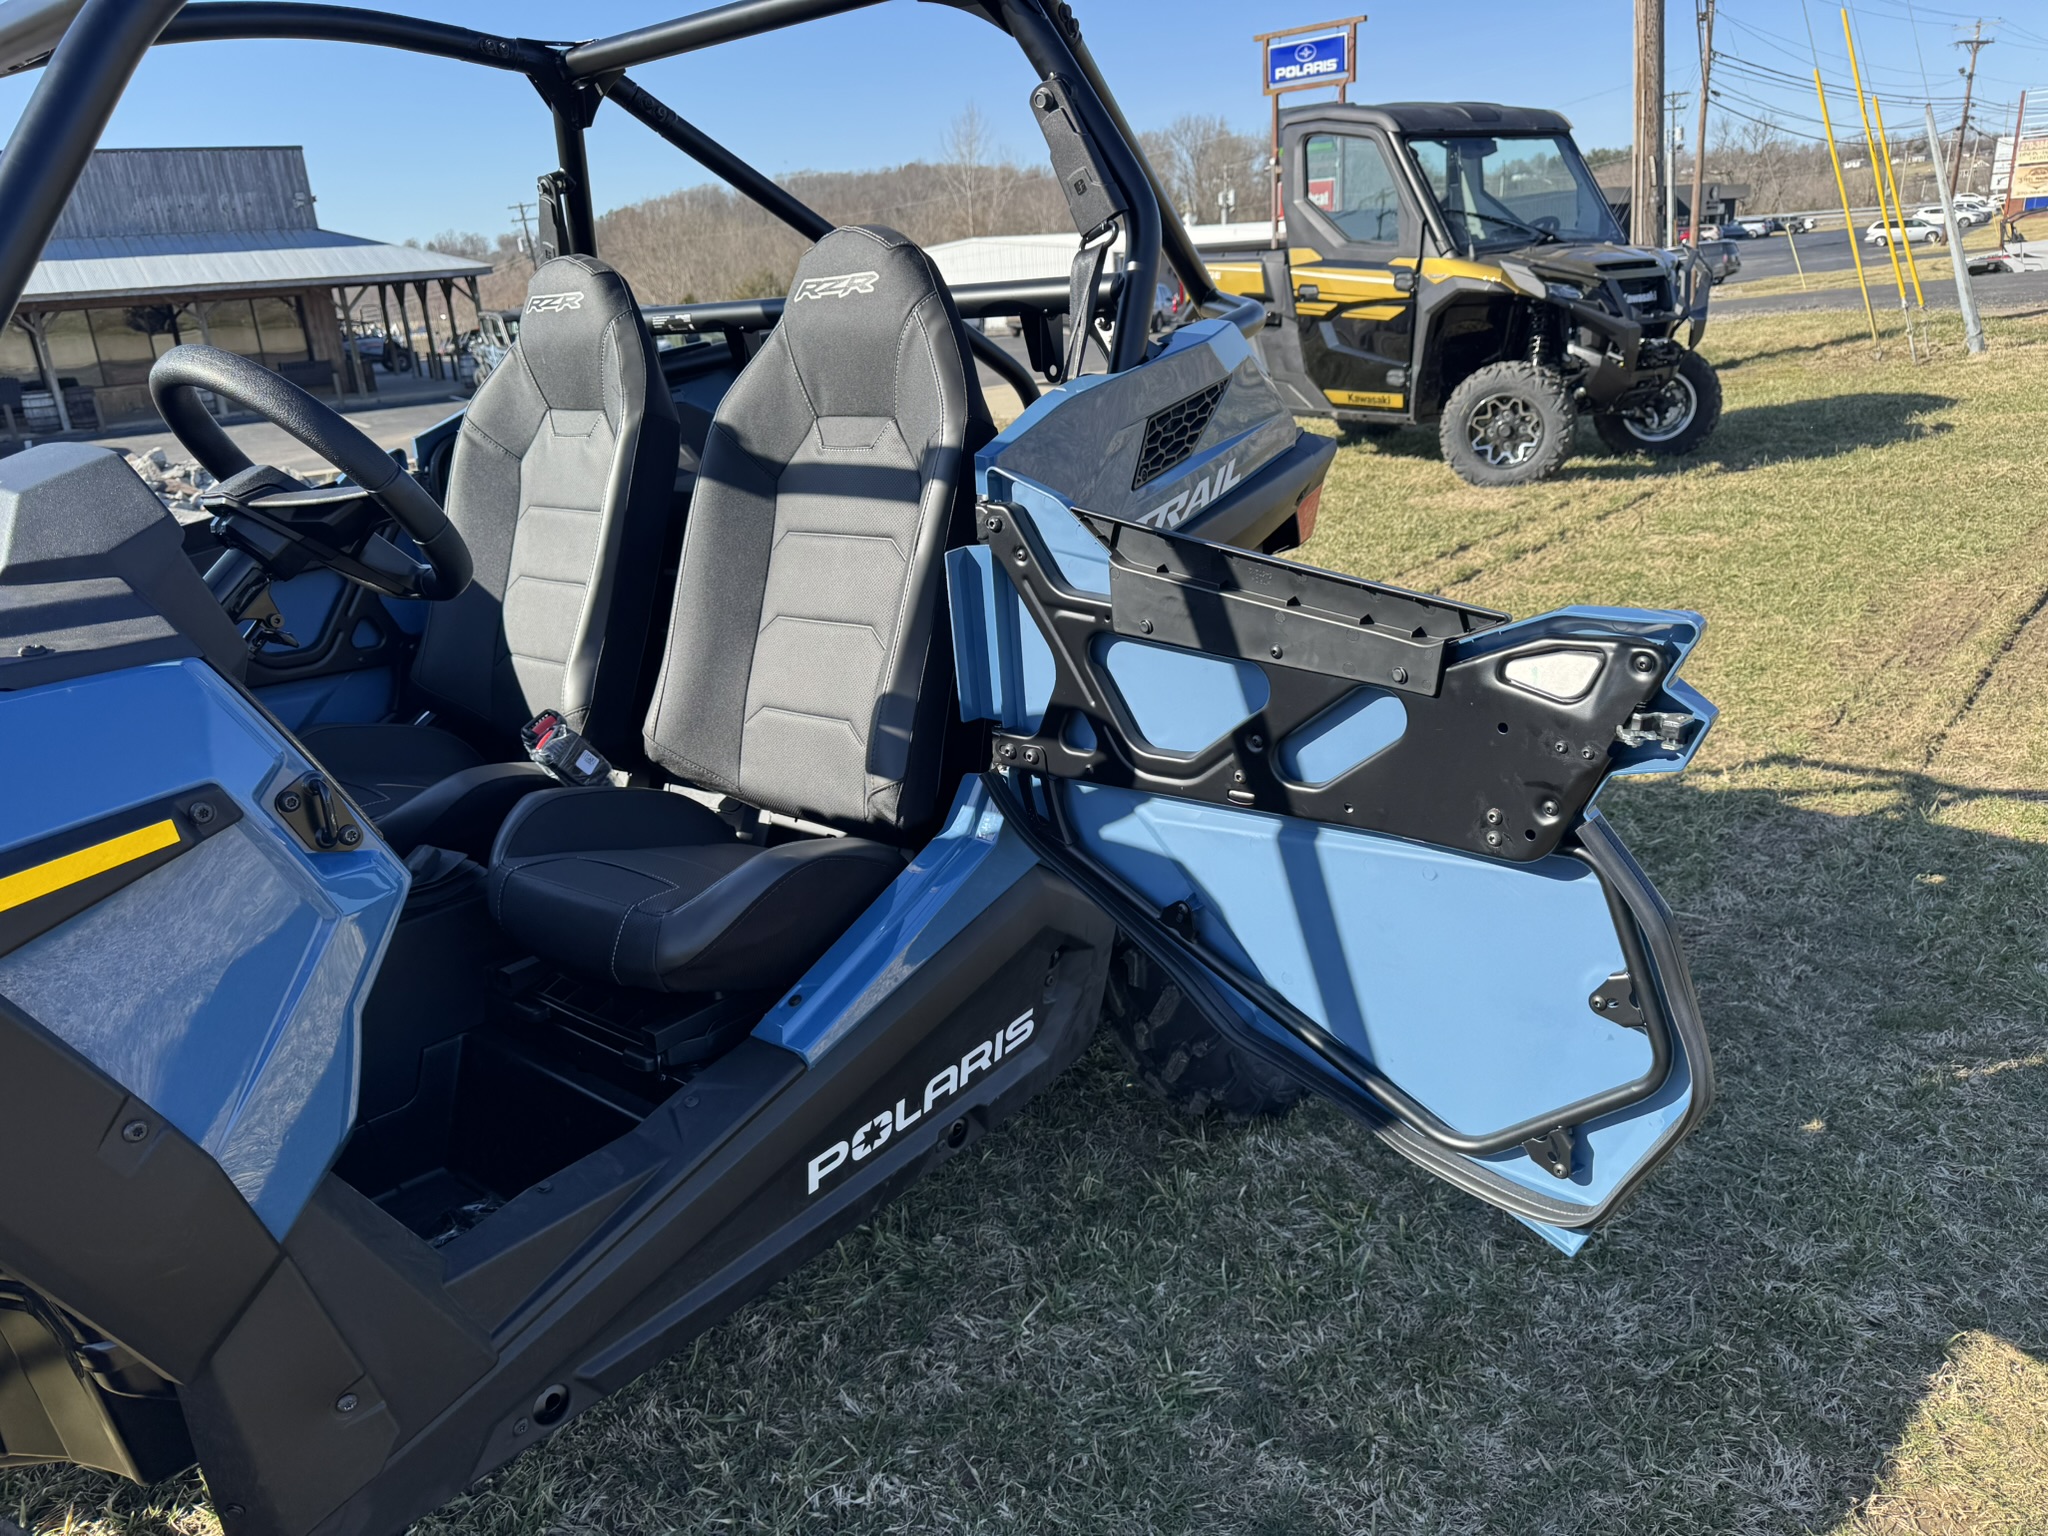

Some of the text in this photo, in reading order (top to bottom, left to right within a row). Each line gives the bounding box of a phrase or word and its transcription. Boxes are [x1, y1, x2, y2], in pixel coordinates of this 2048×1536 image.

[1275, 58, 1338, 81] POLARIS
[794, 270, 880, 303] RZR
[526, 291, 585, 315] RZR
[1347, 393, 1391, 405] Kawasaki
[1135, 457, 1241, 528] TRAIL
[807, 1007, 1034, 1195] POLARIS
